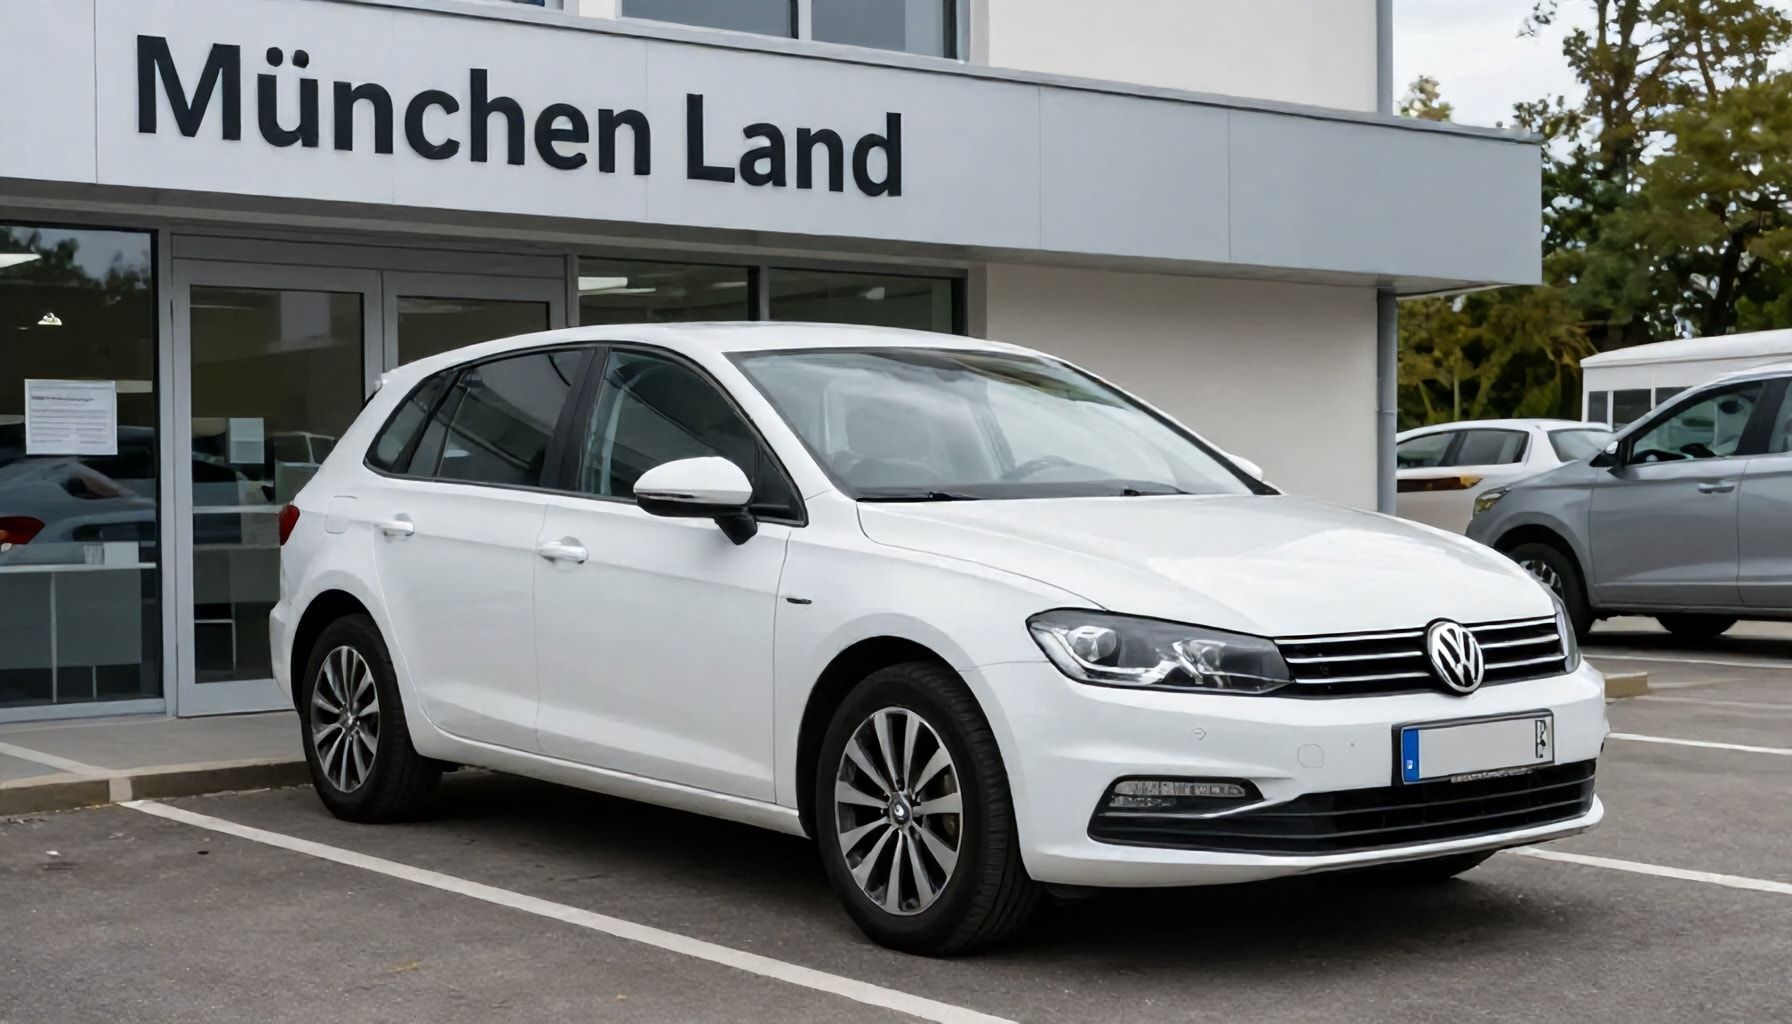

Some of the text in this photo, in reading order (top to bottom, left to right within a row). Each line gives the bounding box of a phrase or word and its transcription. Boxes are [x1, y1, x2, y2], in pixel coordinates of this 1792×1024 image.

[137, 35, 903, 197] München Land
[1429, 620, 1485, 692] VW
